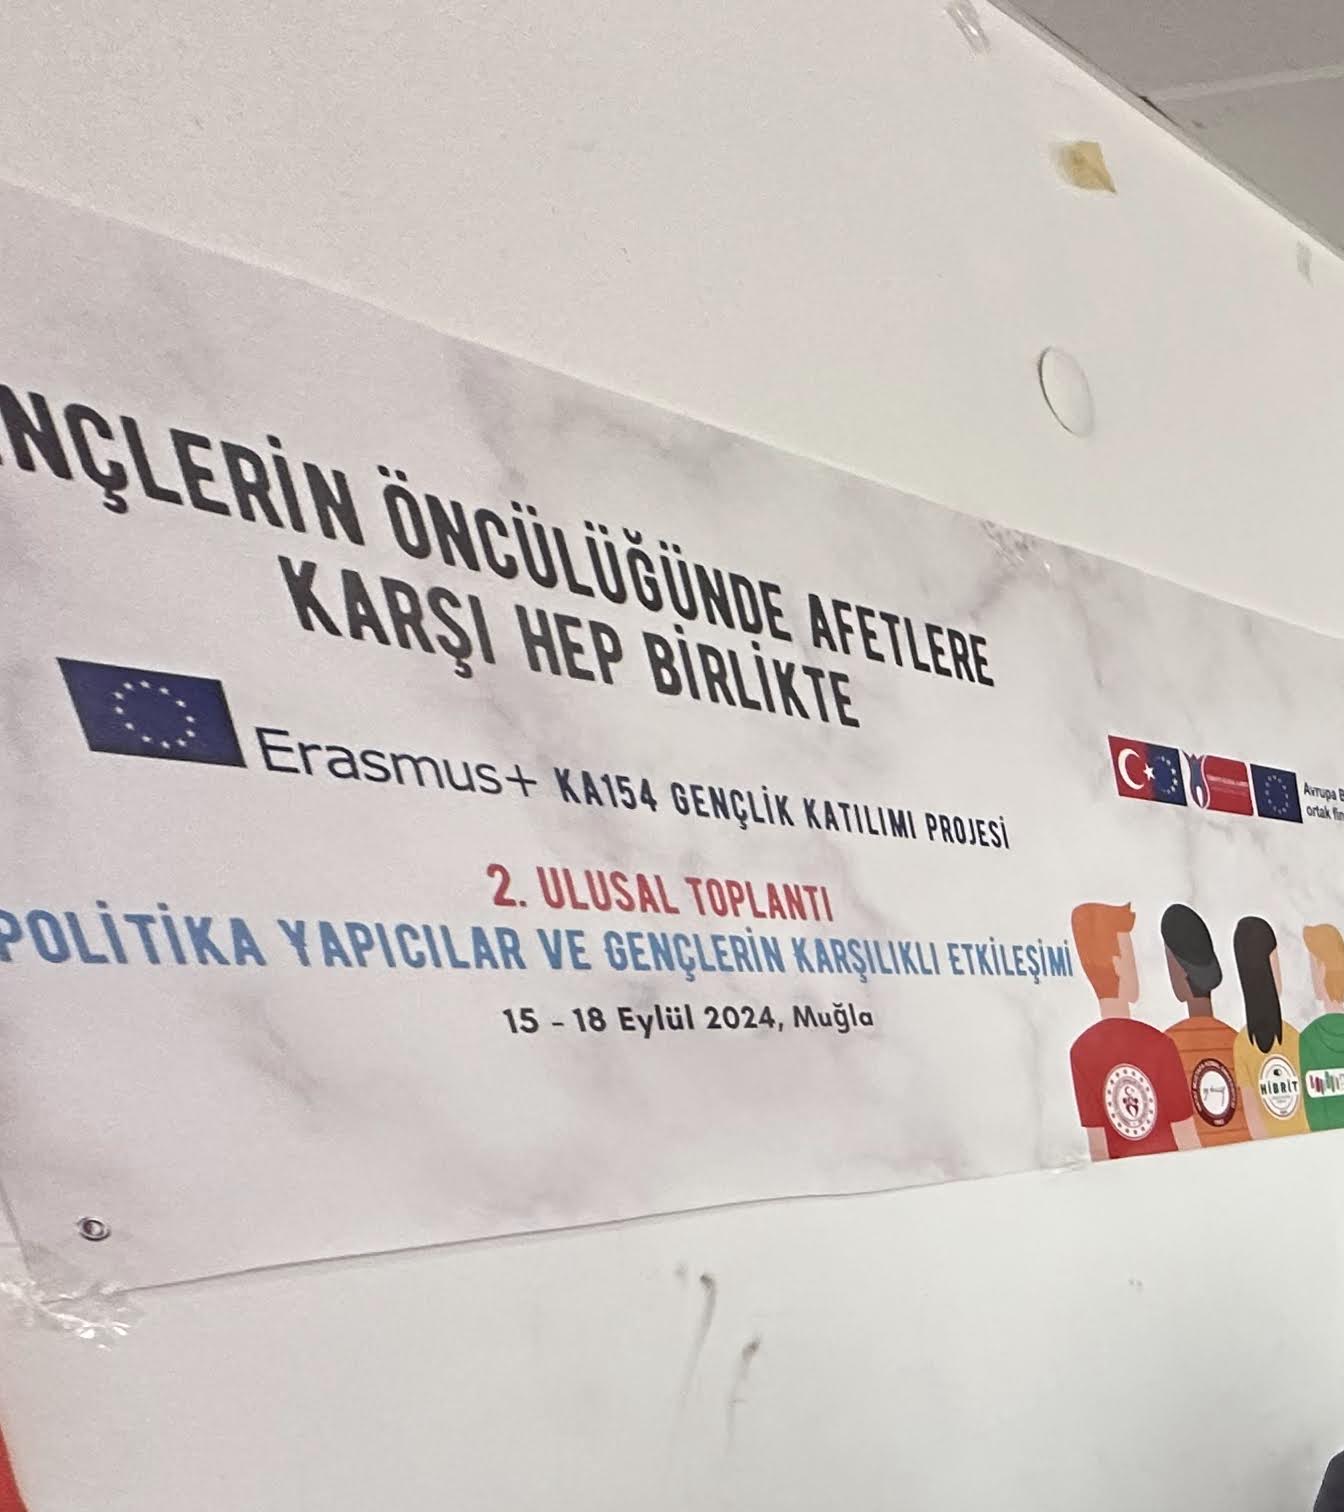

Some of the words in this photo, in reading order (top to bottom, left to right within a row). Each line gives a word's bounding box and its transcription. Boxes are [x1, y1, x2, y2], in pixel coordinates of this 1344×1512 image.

[0, 384, 366, 546] NÇLERİN
[377, 465, 793, 642] ÖNCÜLÜĞÜNDE
[808, 593, 995, 687] AFETLERE
[278, 556, 497, 679] KARŞI
[515, 605, 625, 685] HEP
[645, 623, 862, 729] BİRLİKTE
[254, 727, 539, 799] Erasmus+
[1303, 782, 1337, 801] Avrupa
[555, 767, 659, 814] KA154
[671, 783, 796, 831] GENÇLİK
[803, 797, 917, 841] KATILIMI
[925, 815, 1010, 850] PROJESİ
[1306, 805, 1331, 819] ortak
[486, 864, 527, 909] 2.
[537, 867, 680, 916] ULUSAL
[685, 877, 834, 923] TOPLANTI
[0, 899, 265, 968] POLİTİKA
[277, 918, 527, 970] YAPICILAR
[543, 928, 592, 972] VE
[603, 925, 786, 982] GENÇLERİN
[793, 931, 941, 983] KARŞILIKLI
[950, 937, 1073, 987] ETKİLEŞİMİ
[502, 1007, 540, 1034] 15
[573, 1007, 606, 1034] 18
[618, 1004, 695, 1040] Eylül
[704, 1005, 785, 1035] 2024,
[792, 1003, 875, 1036] Muğla
[1260, 1080, 1298, 1095] HİBRİT
